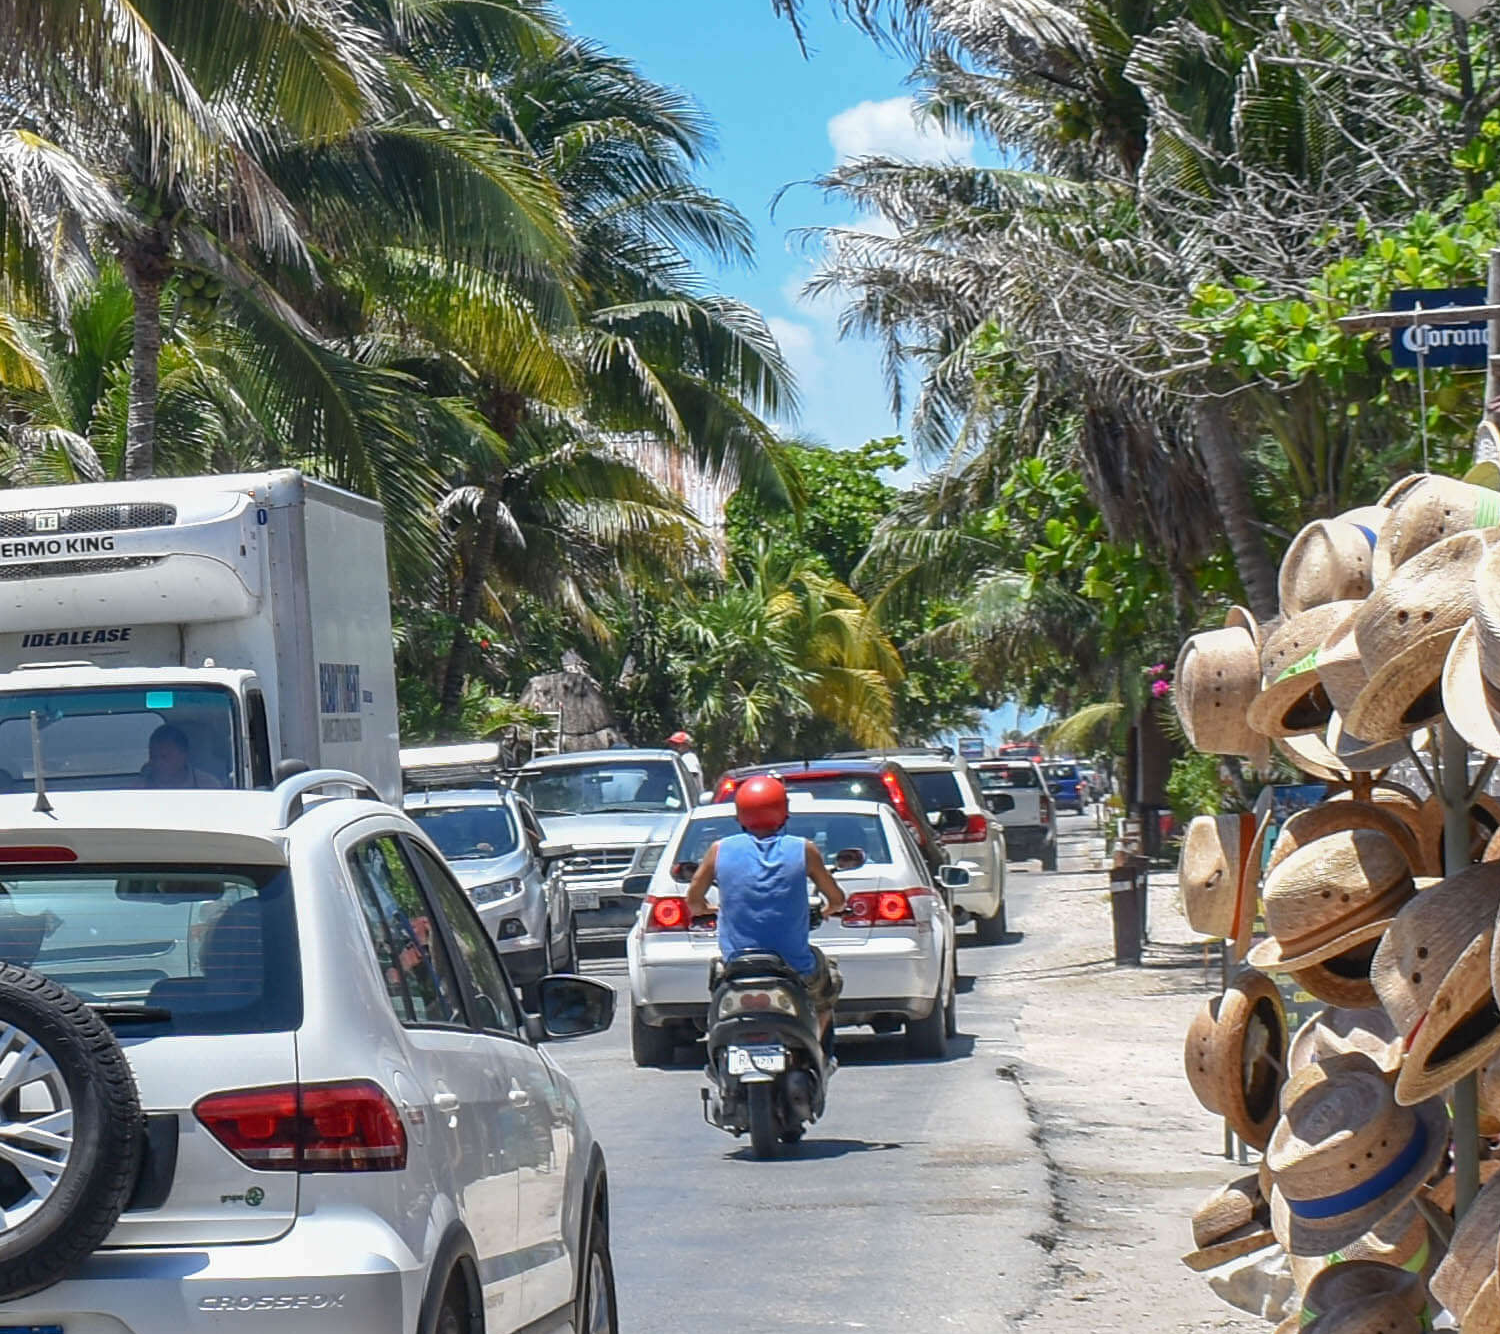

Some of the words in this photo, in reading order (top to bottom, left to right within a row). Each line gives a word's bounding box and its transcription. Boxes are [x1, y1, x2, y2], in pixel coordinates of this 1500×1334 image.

[66, 536, 115, 554] KING
[21, 627, 132, 648] IDEALEASE
[198, 1292, 346, 1311] CROSSFOX
